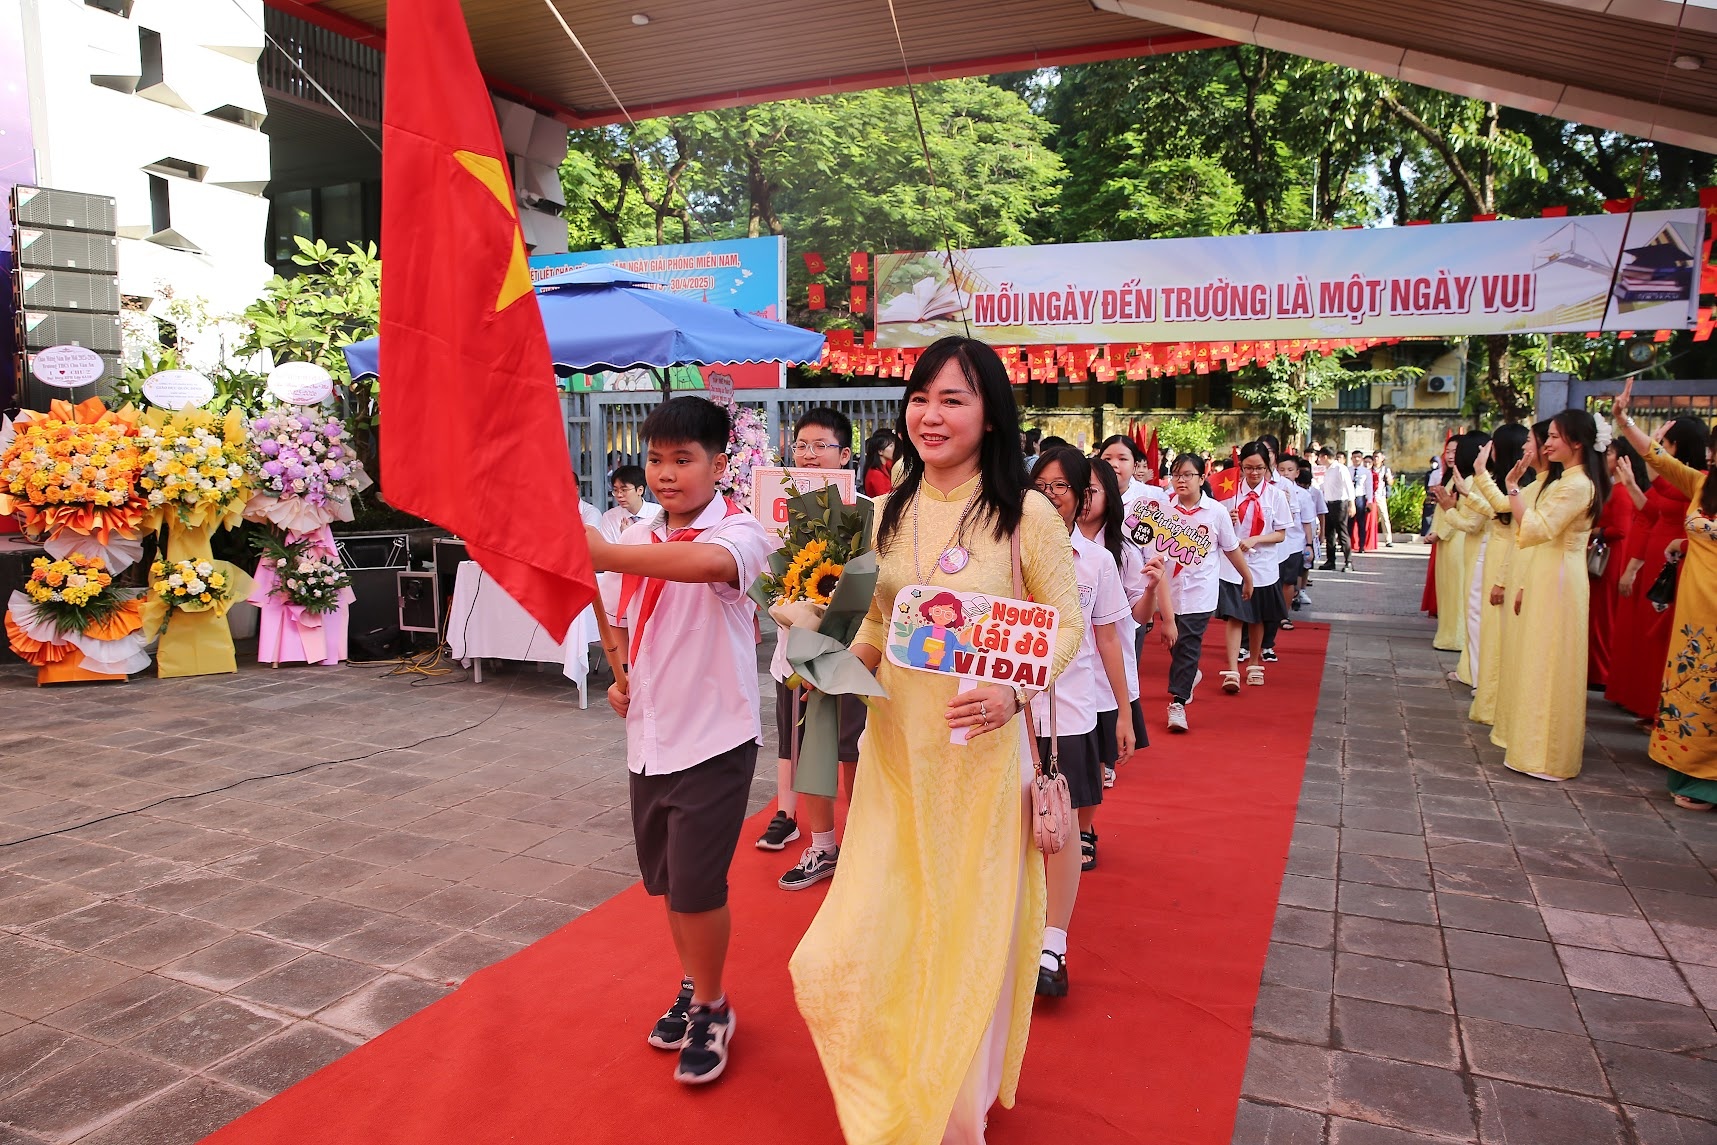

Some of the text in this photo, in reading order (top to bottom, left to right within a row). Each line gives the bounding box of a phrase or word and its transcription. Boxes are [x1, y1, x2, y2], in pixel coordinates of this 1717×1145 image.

[628, 258, 649, 272] NGÀY
[650, 256, 666, 271] GIẢI
[667, 256, 694, 271] PHÓNG
[975, 270, 1532, 324] MỖI NGÀY ĐẾN TRƯỜNG LÀ MỘT NGÀY VUI
[1133, 500, 1151, 520] Lớp
[991, 601, 1055, 630] Người
[1015, 631, 1049, 658] đò
[953, 647, 1048, 688] VĨ ĐẠI
